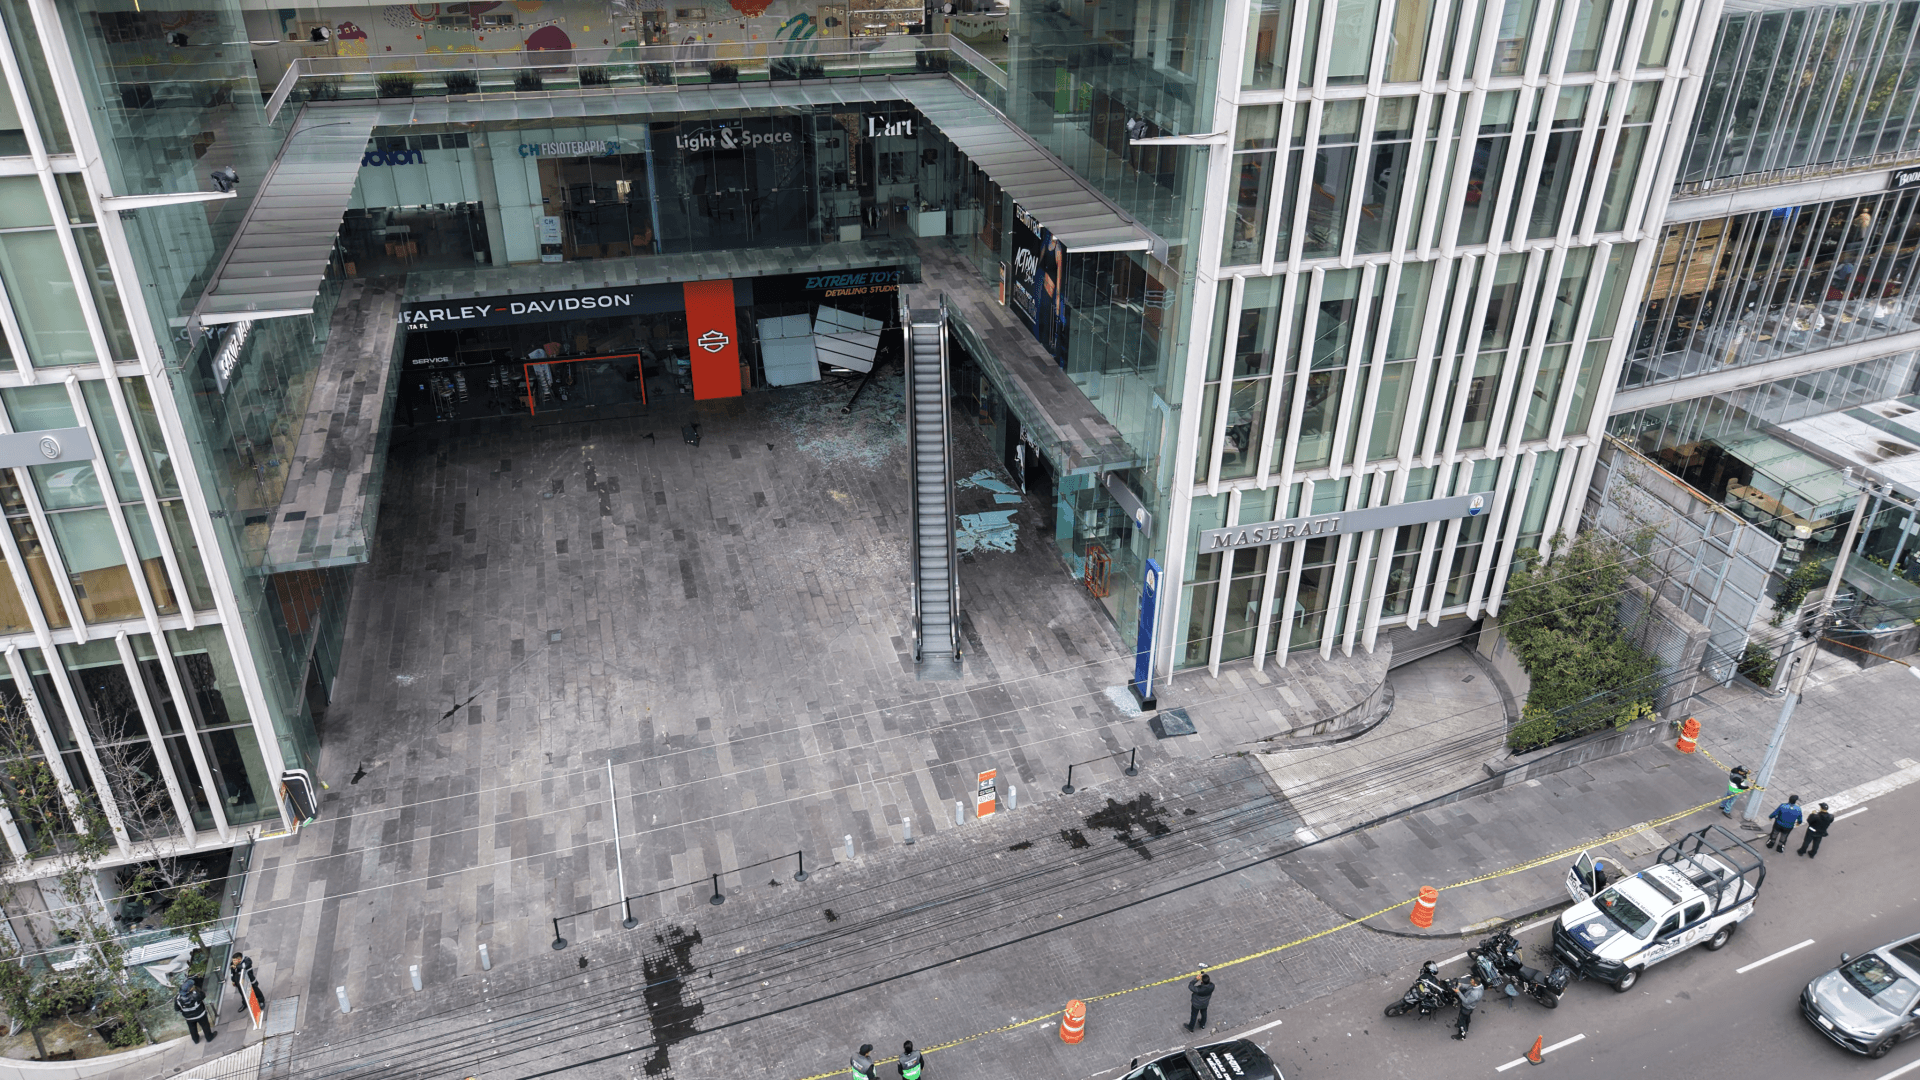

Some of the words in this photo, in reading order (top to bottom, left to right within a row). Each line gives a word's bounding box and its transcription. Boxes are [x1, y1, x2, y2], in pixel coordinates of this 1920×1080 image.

[676, 134, 716, 151] Light
[720, 127, 739, 149] &
[741, 130, 793, 149] Space
[518, 143, 540, 158] CH
[805, 273, 868, 289] EXTREME
[869, 270, 900, 283] TOYS
[824, 287, 867, 297] DETAILING
[412, 356, 449, 365] SERVICE
[1210, 516, 1341, 550] MASERATI
